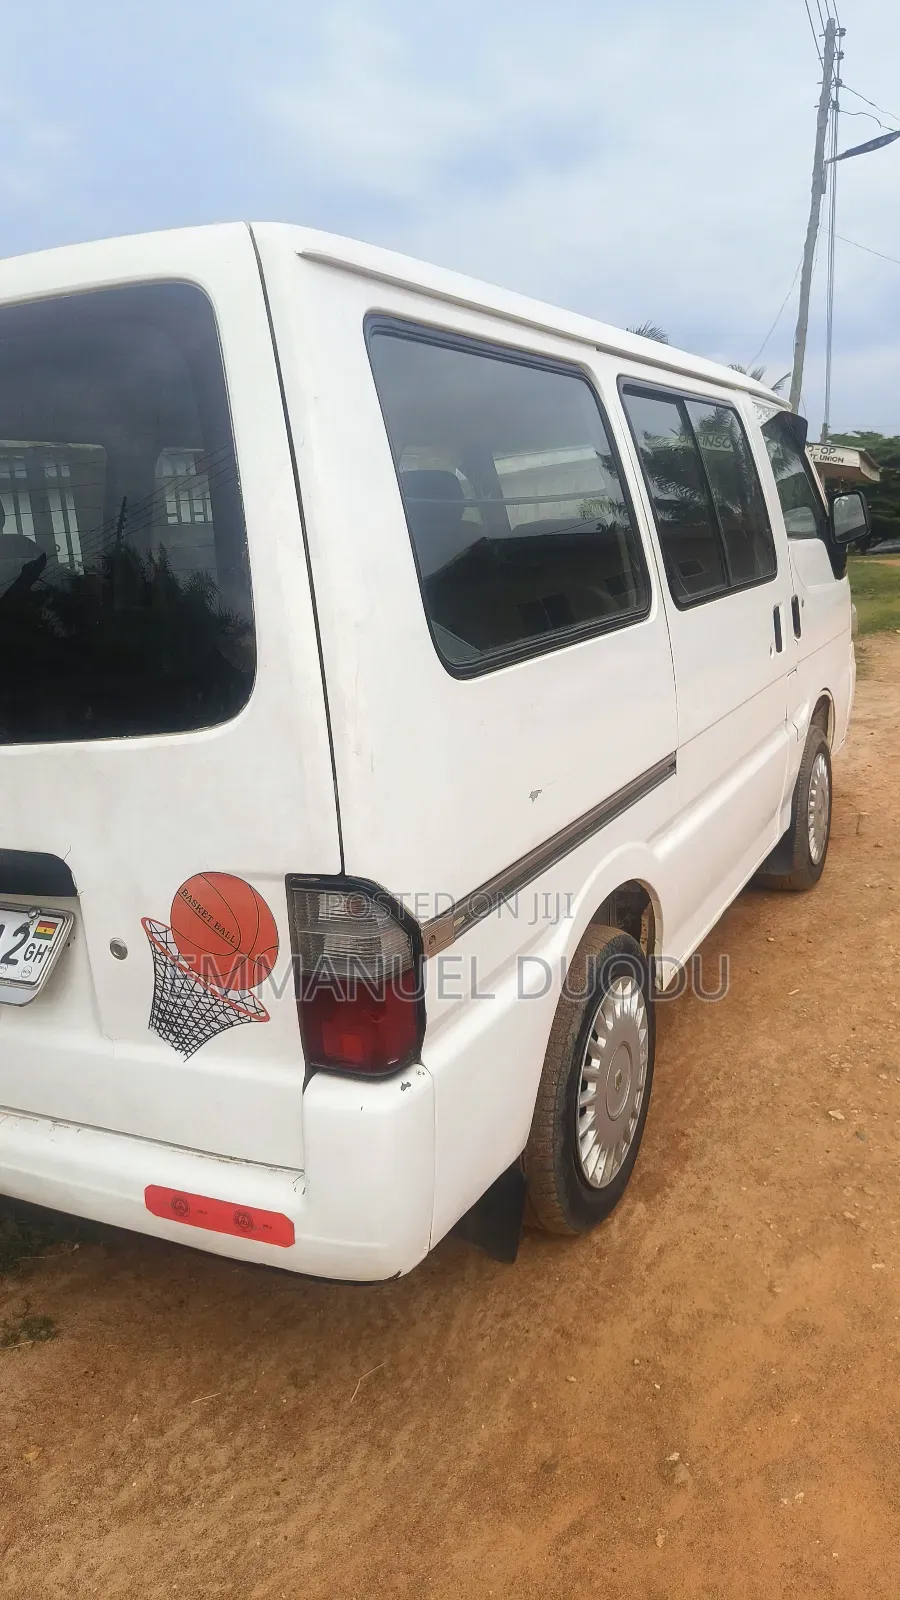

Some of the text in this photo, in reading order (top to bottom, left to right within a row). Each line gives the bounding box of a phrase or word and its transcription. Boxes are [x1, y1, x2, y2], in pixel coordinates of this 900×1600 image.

[819, 453, 845, 464] UNION
[181, 888, 236, 944] BASKET BALL
[23, 942, 48, 964] GH
